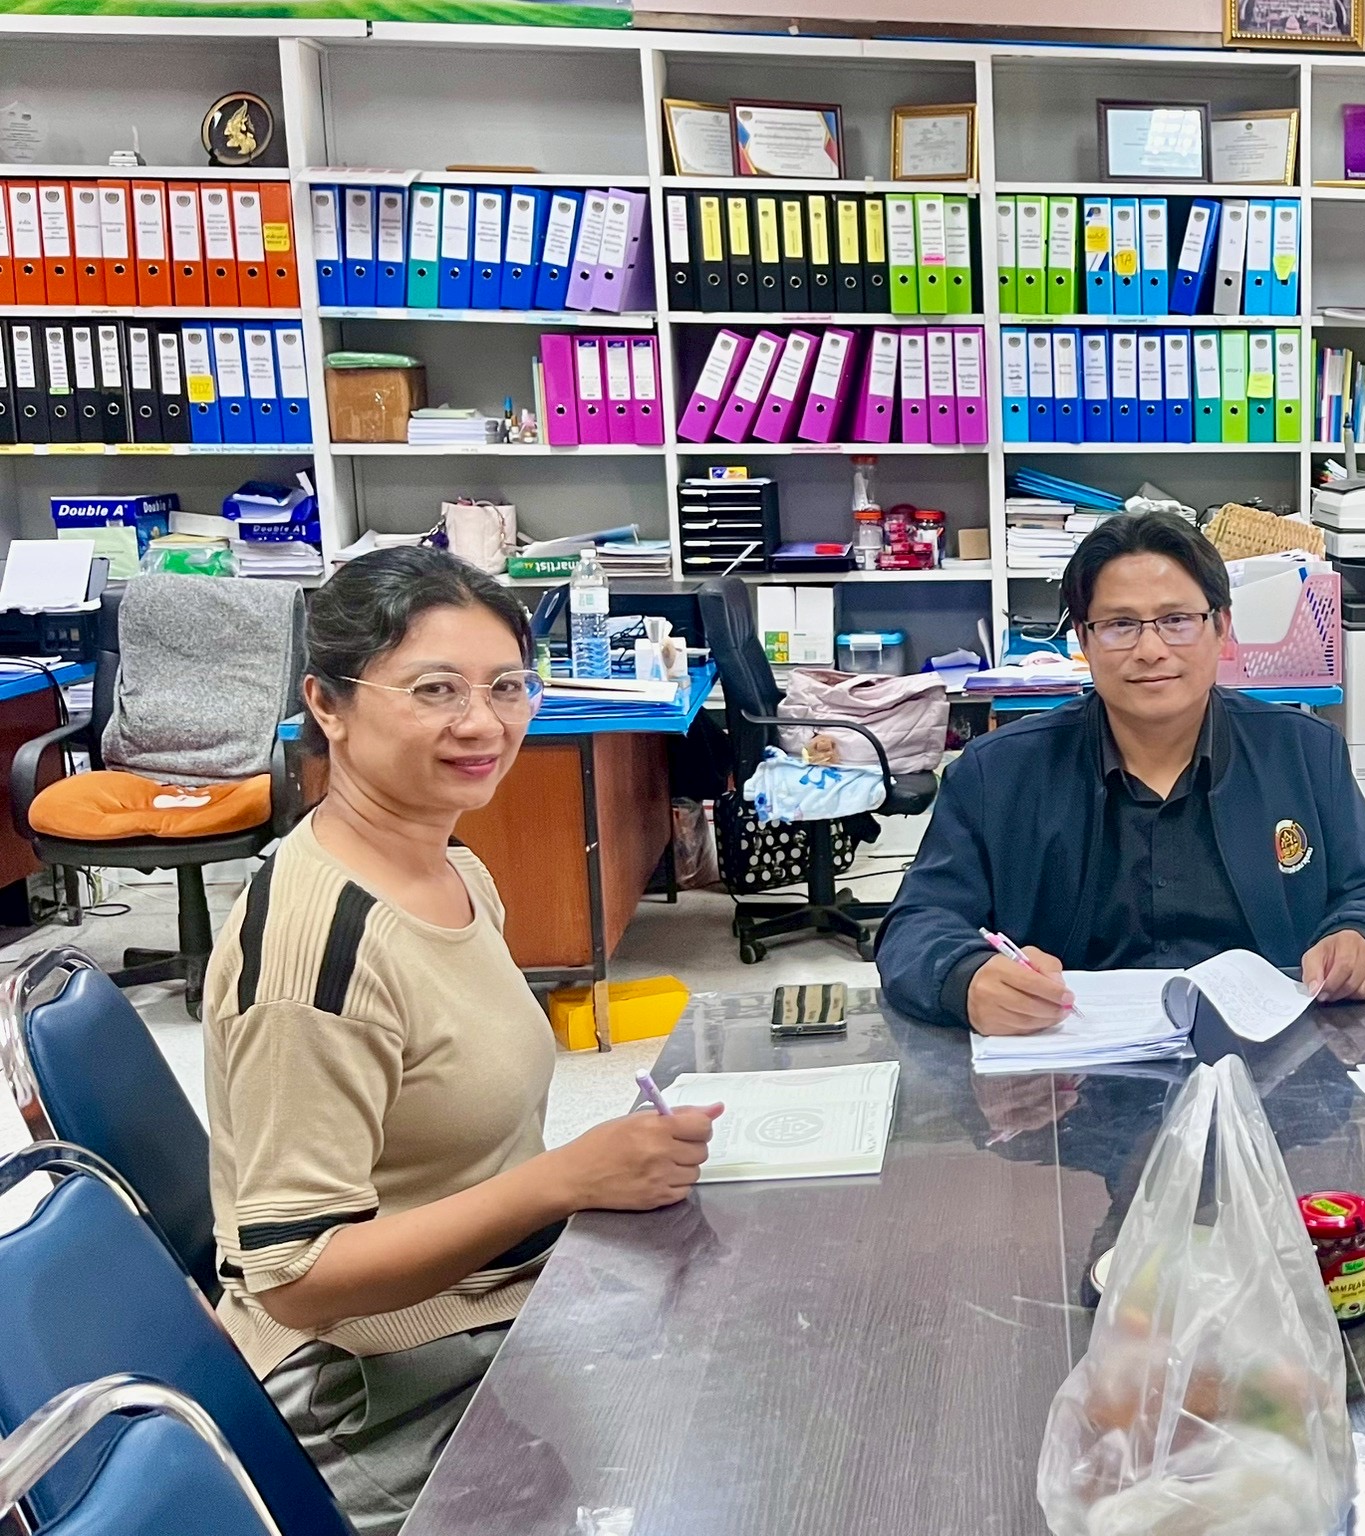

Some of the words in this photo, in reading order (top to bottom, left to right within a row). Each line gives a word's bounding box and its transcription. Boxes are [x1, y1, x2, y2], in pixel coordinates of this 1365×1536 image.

[58, 504, 109, 516] Double
[112, 504, 124, 516] A
[253, 524, 289, 533] Double
[292, 524, 300, 533] A
